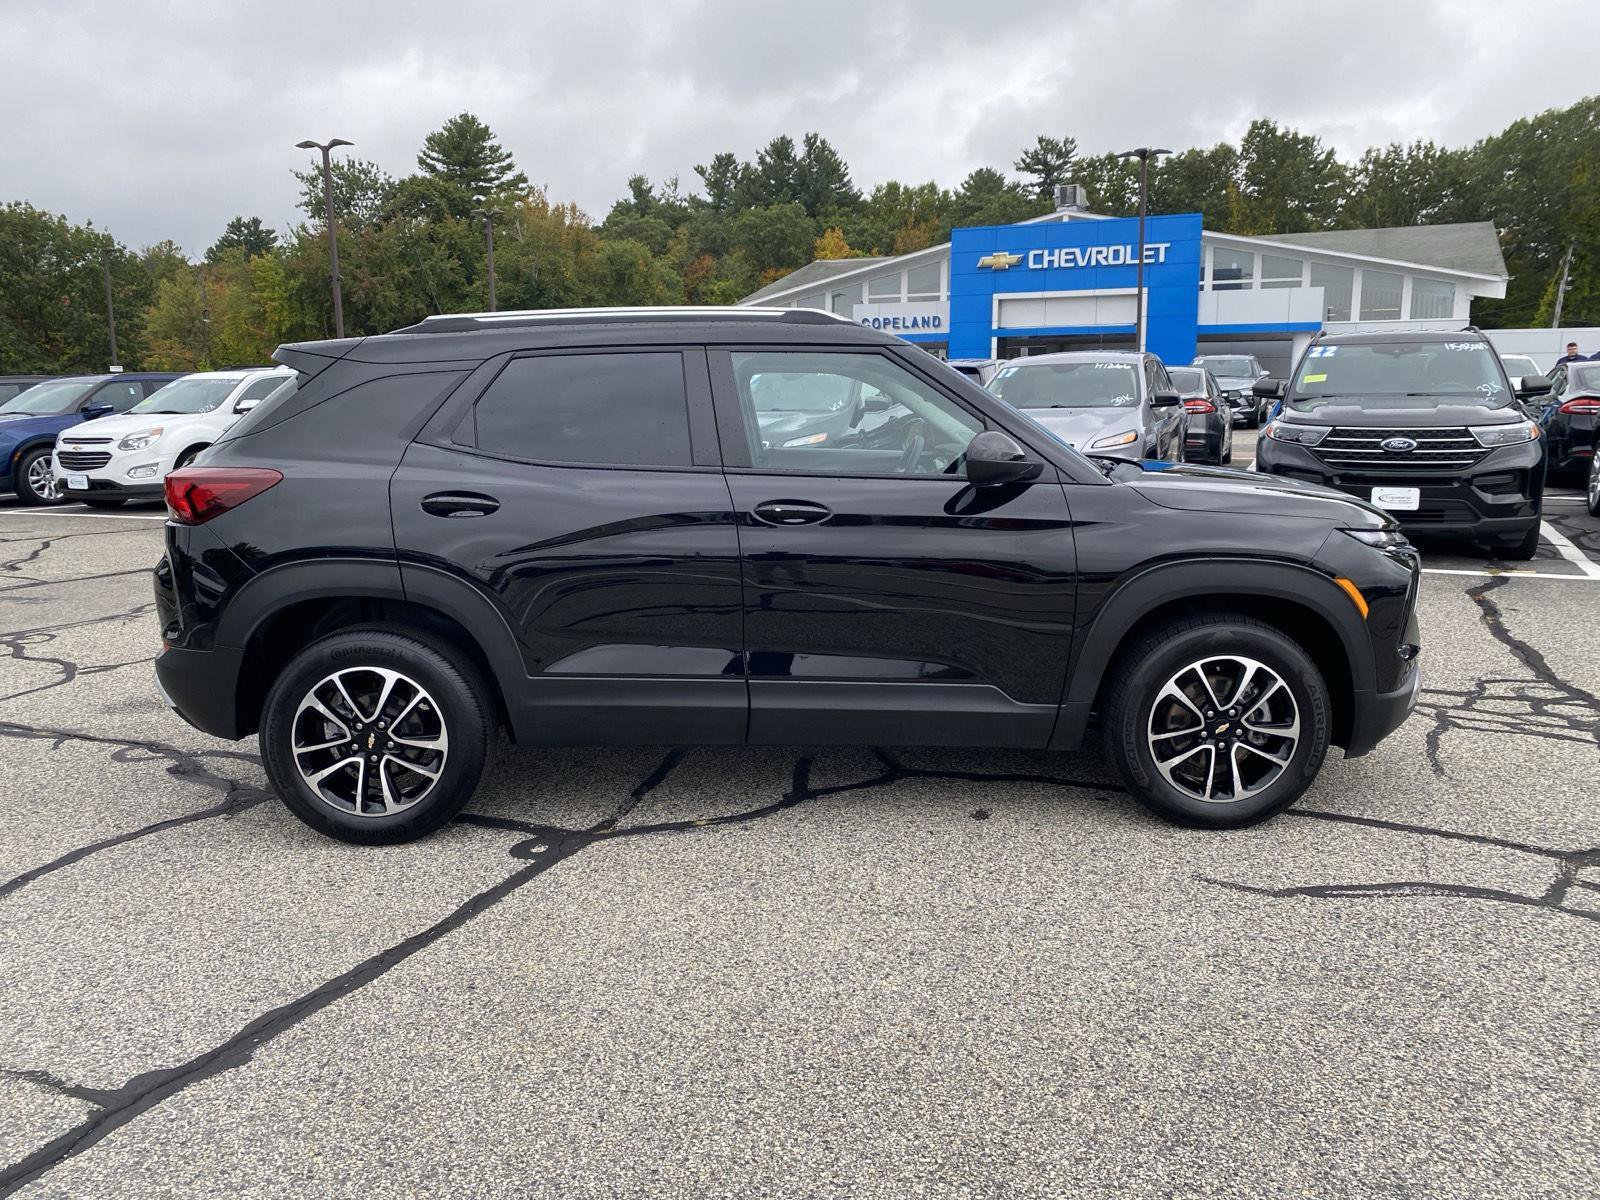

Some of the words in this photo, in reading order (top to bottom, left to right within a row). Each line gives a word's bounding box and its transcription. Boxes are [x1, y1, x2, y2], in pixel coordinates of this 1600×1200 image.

[1028, 243, 1171, 269] CHEVROLET
[861, 315, 942, 330] COPELAND
[1308, 345, 1338, 358] 22
[330, 645, 396, 660] Continental
[1306, 684, 1326, 768] ARROYO
